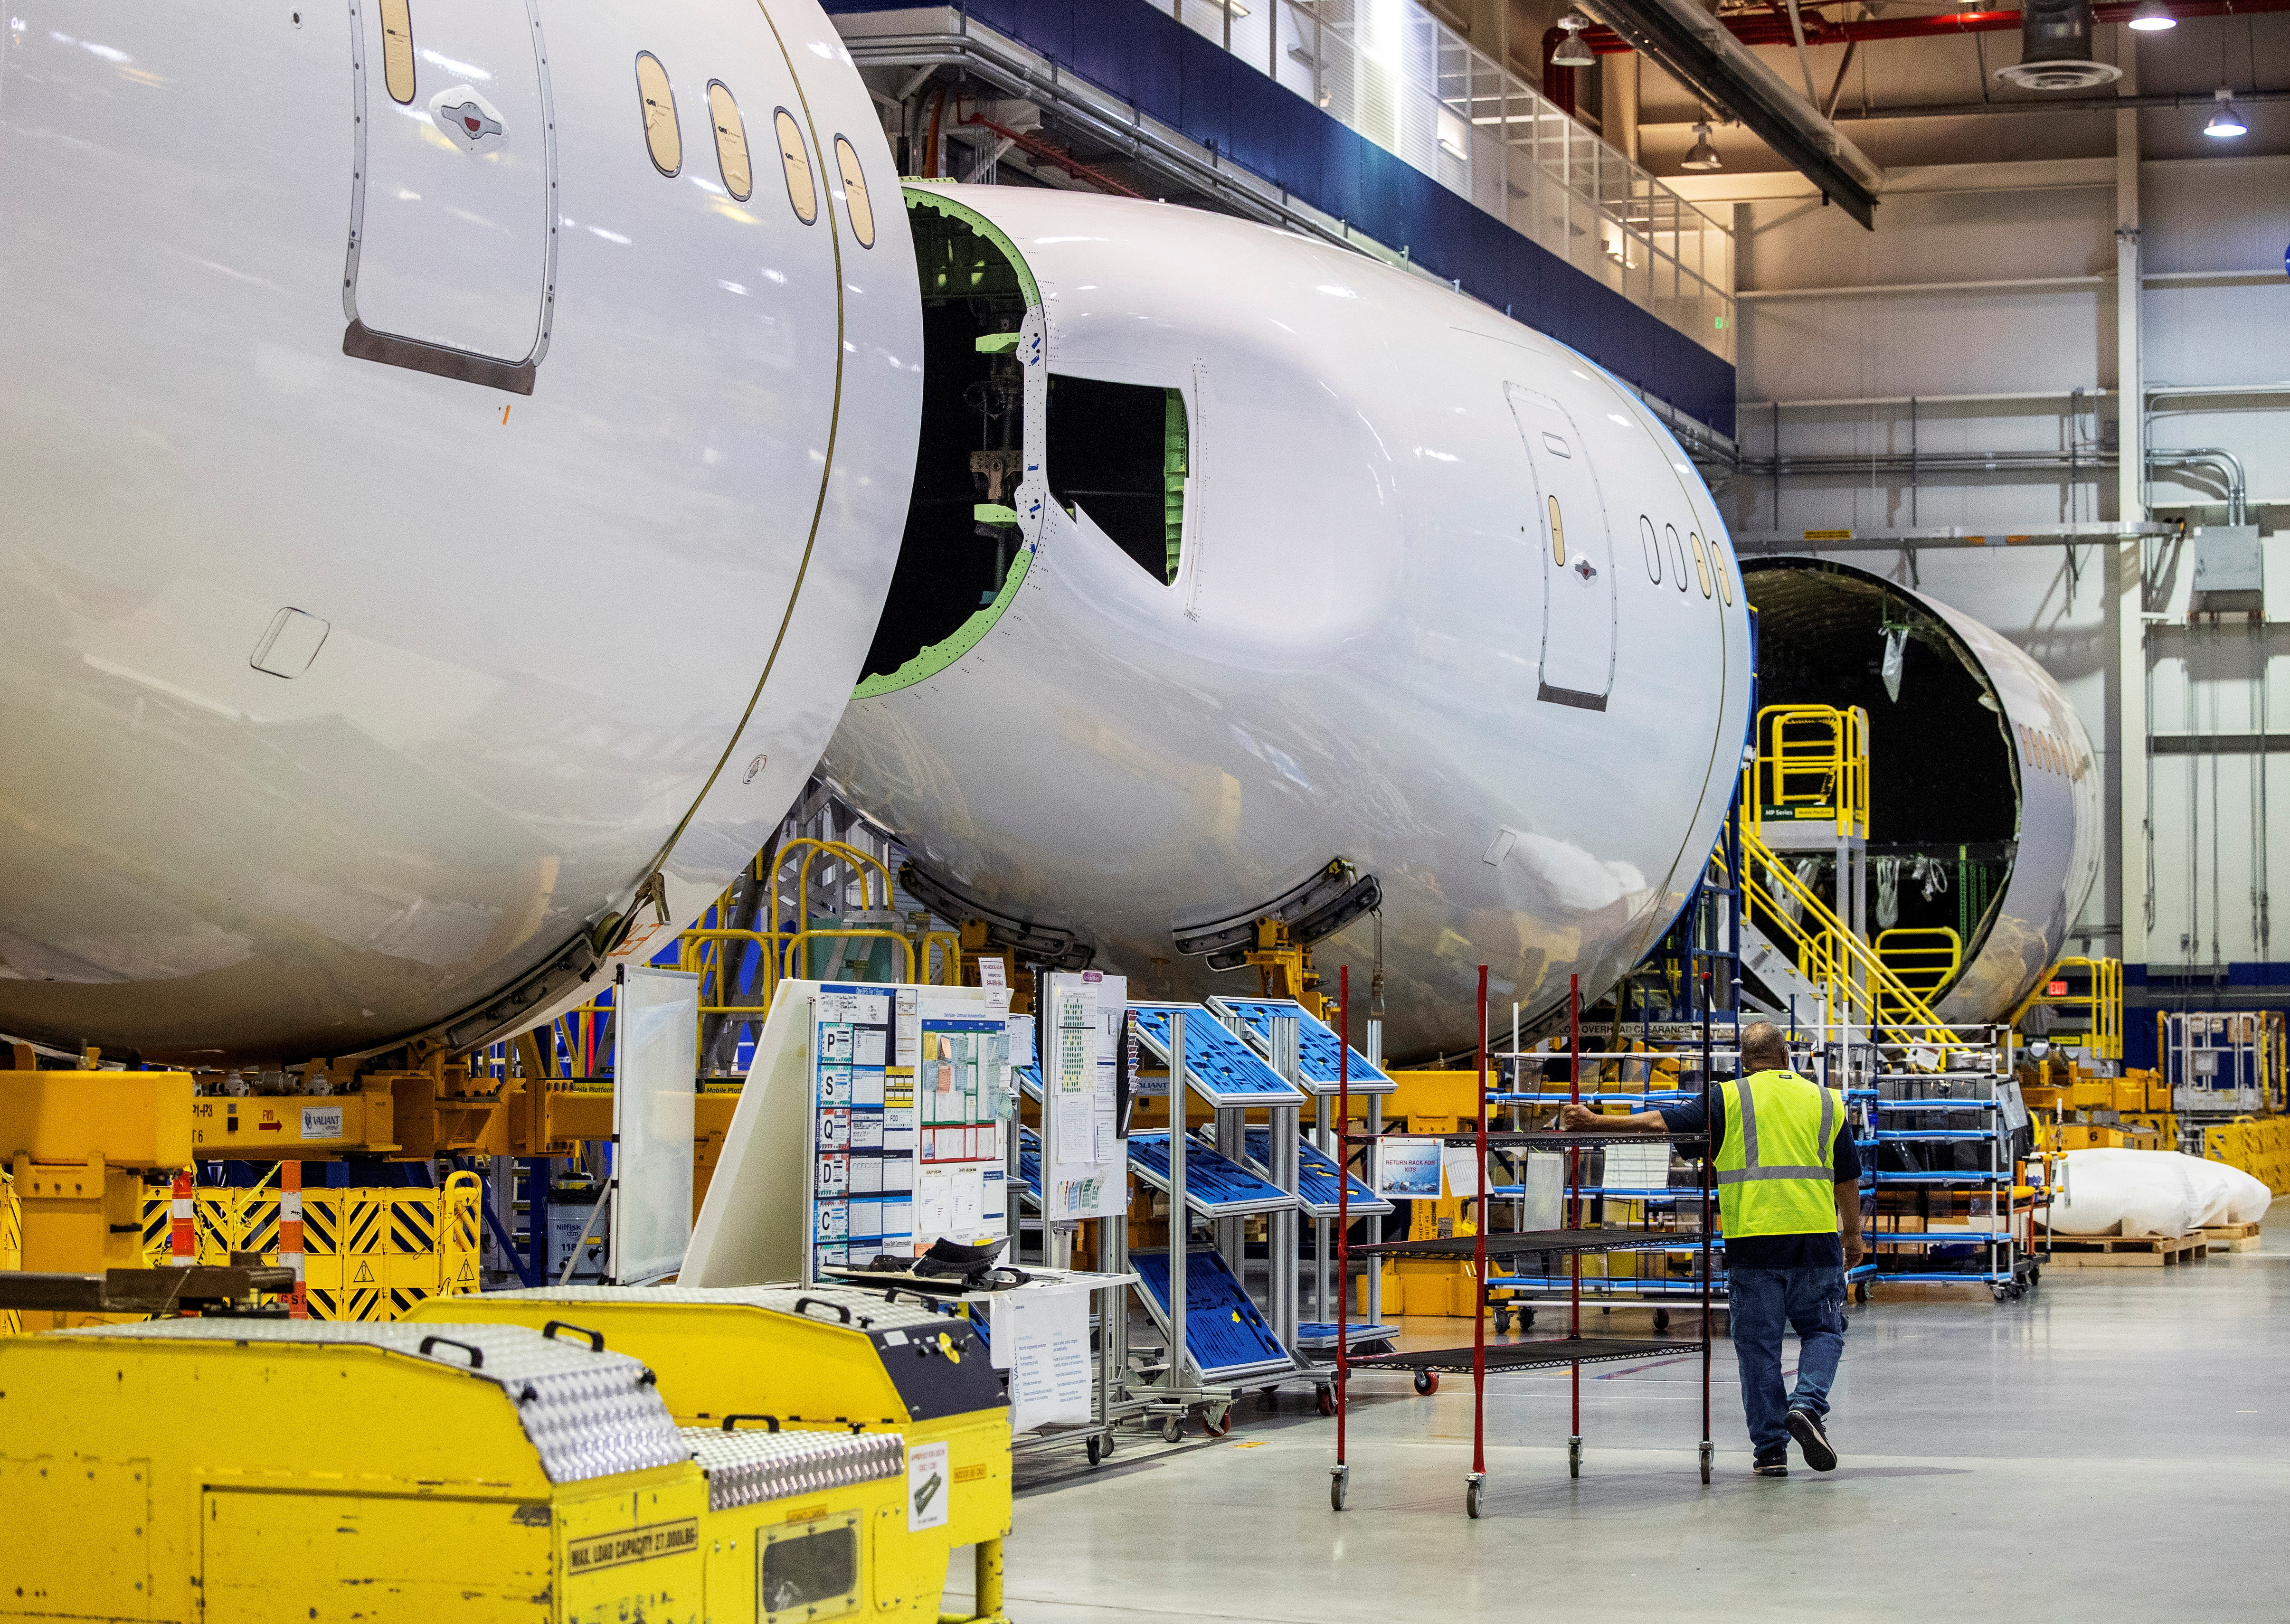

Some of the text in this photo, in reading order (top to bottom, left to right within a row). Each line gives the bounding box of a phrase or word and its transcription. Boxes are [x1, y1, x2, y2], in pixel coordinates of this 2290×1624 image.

[2051, 982, 2064, 994] EXIT
[1582, 1025, 1632, 1033] OVERHAD
[828, 1034, 835, 1052] P
[826, 1076, 833, 1095] S
[313, 1116, 340, 1124] VALIANT
[824, 1120, 833, 1140] Q
[2090, 1132, 2098, 1142] 6
[823, 1163, 831, 1183] D
[823, 1212, 830, 1230] C
